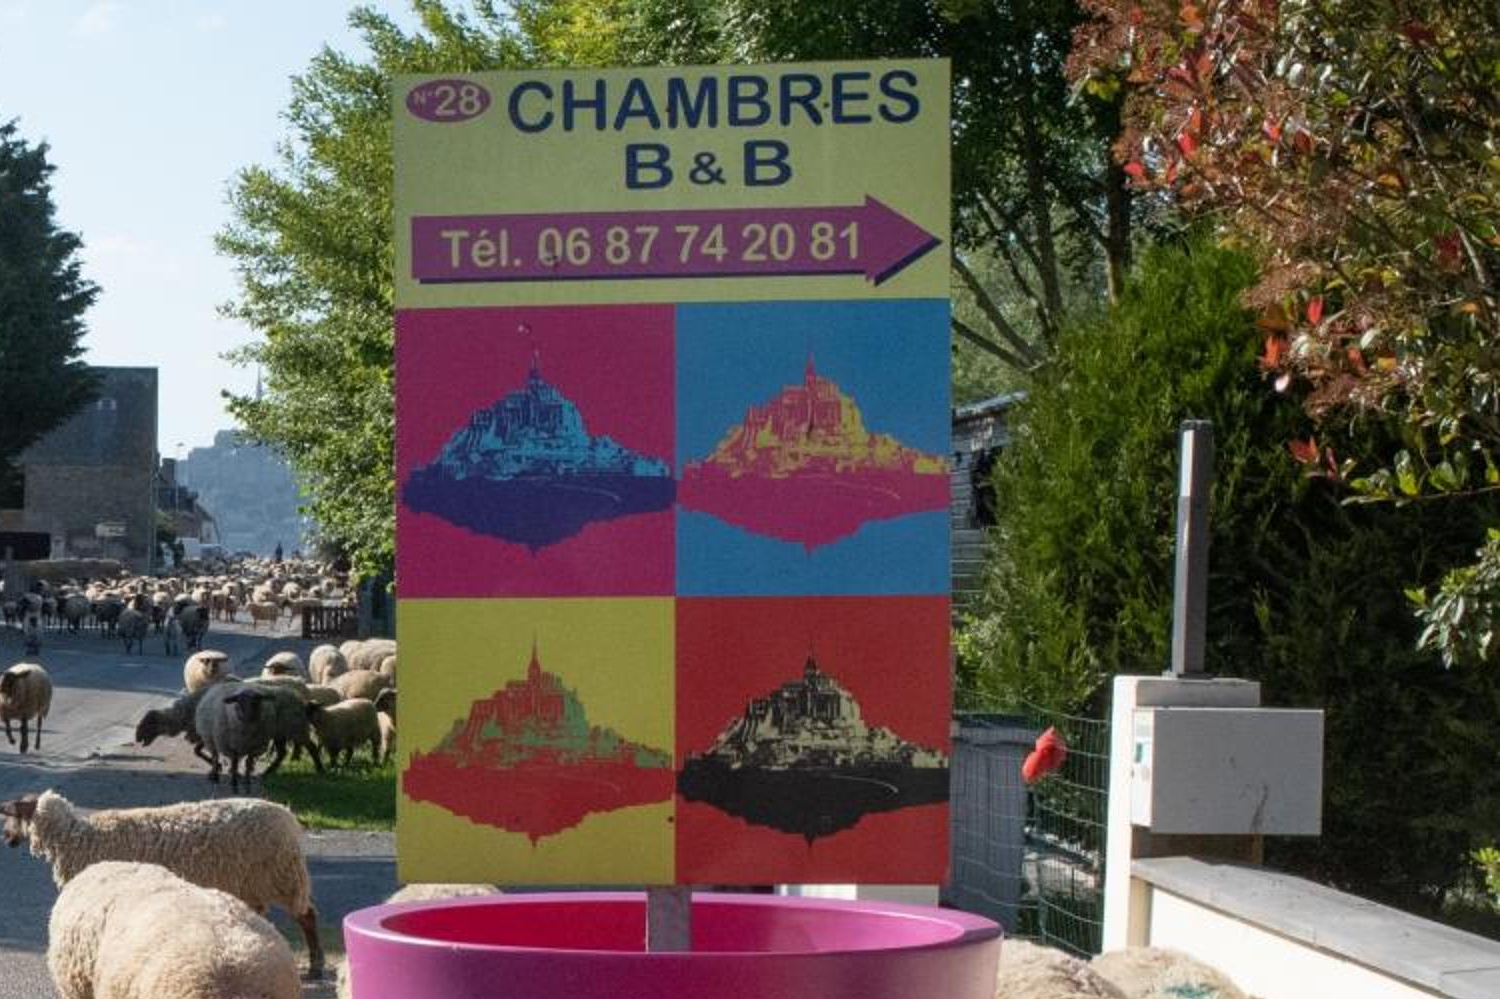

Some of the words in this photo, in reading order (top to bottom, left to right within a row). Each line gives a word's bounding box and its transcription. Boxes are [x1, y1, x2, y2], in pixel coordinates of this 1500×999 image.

[507, 69, 920, 133] CHAMBRES
[625, 142, 674, 190] B
[688, 151, 727, 186] &
[743, 139, 793, 187] B
[441, 228, 522, 268] Tél.
[537, 227, 591, 266] 06
[605, 225, 660, 265] 87
[675, 223, 729, 264] 74
[741, 222, 796, 262] 20
[809, 221, 859, 262] 81
